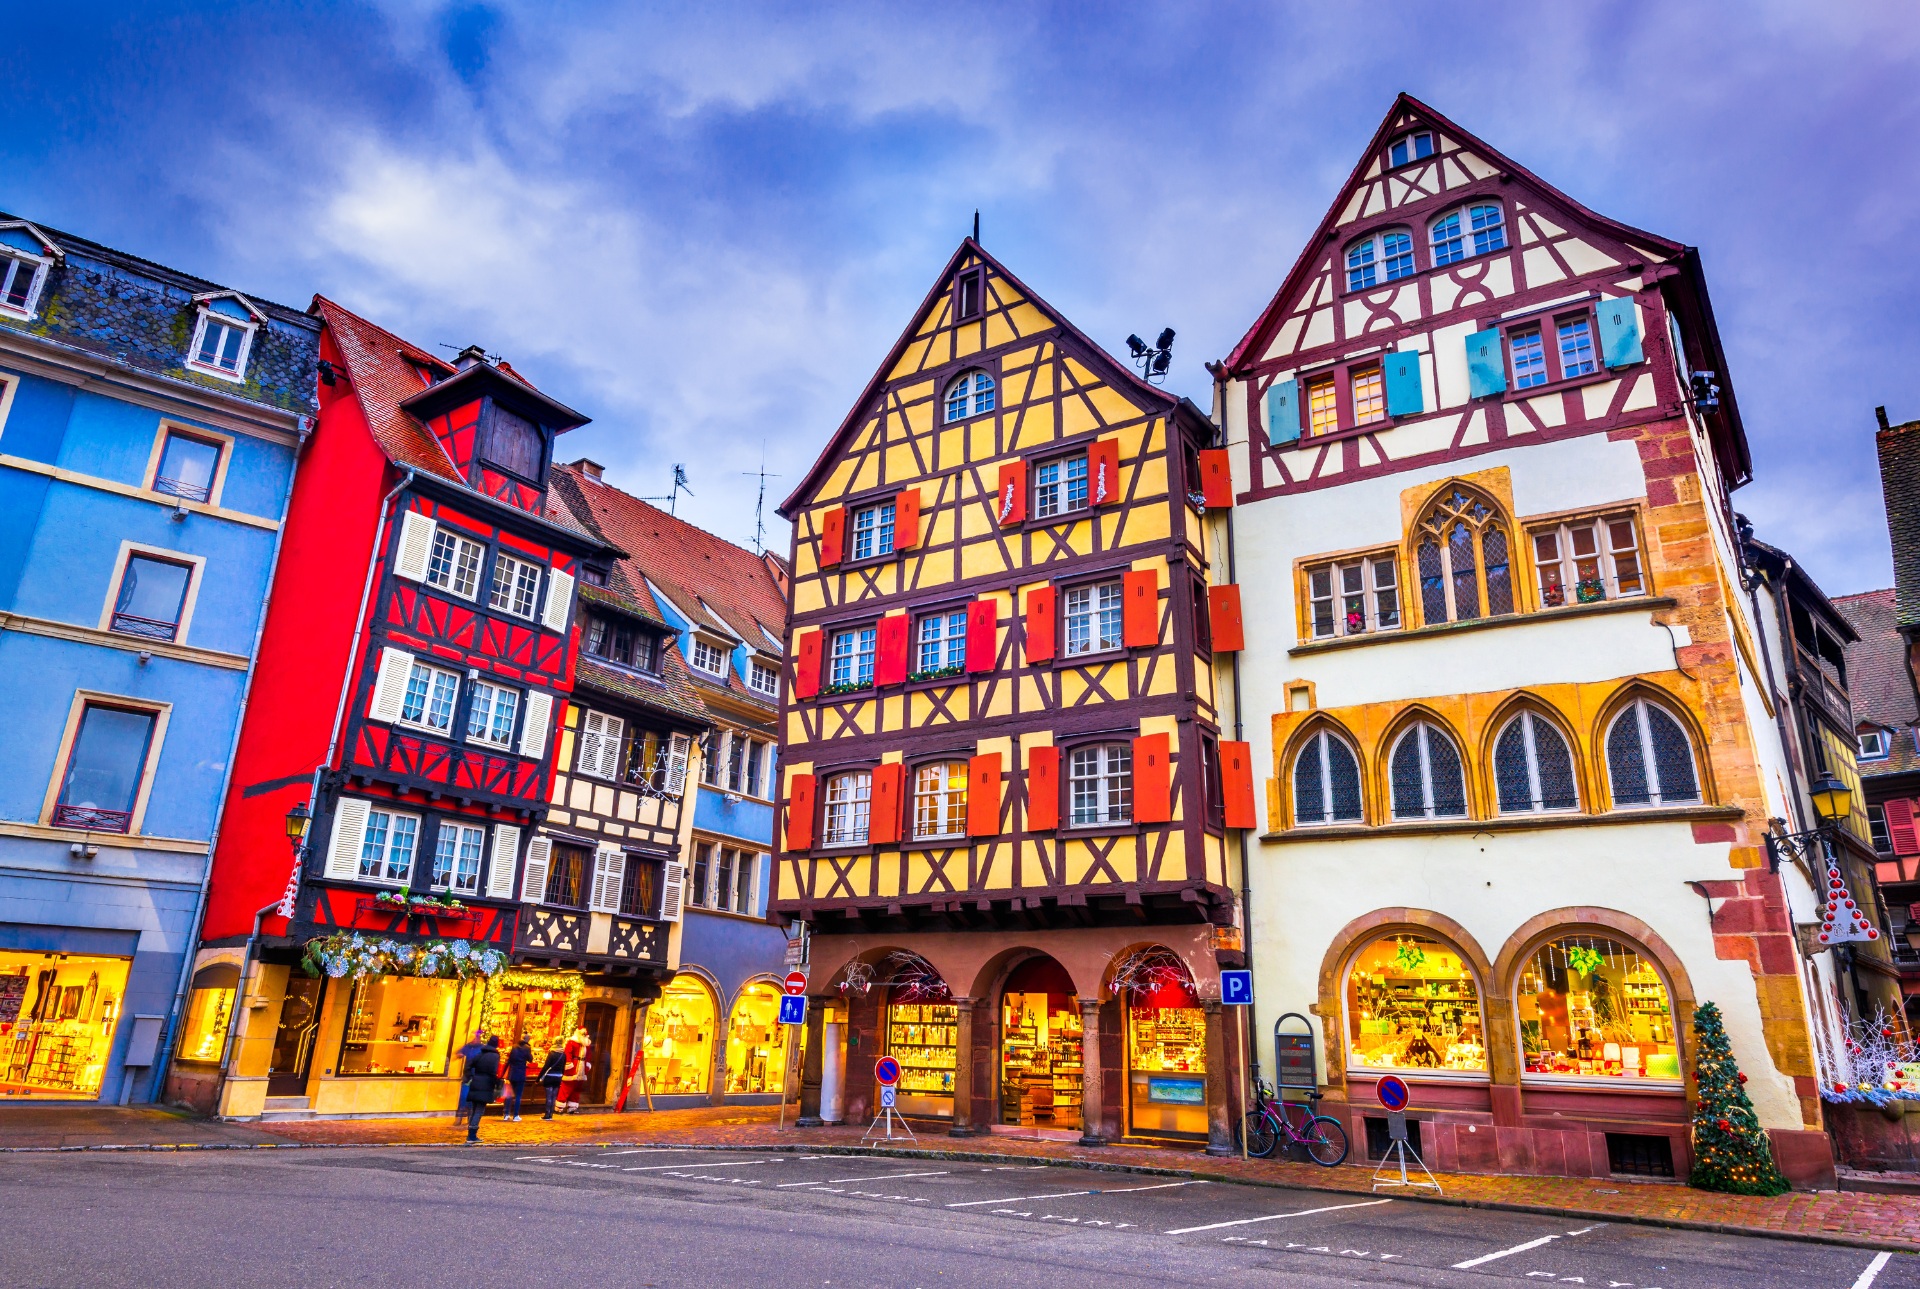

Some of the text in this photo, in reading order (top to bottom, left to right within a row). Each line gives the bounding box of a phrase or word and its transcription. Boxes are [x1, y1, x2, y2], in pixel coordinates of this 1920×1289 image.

[1230, 977, 1243, 998] P
[990, 1208, 1139, 1229] PAYANT
[1220, 1236, 1403, 1259] PAYANT
[1524, 1270, 1663, 1289] PAY
